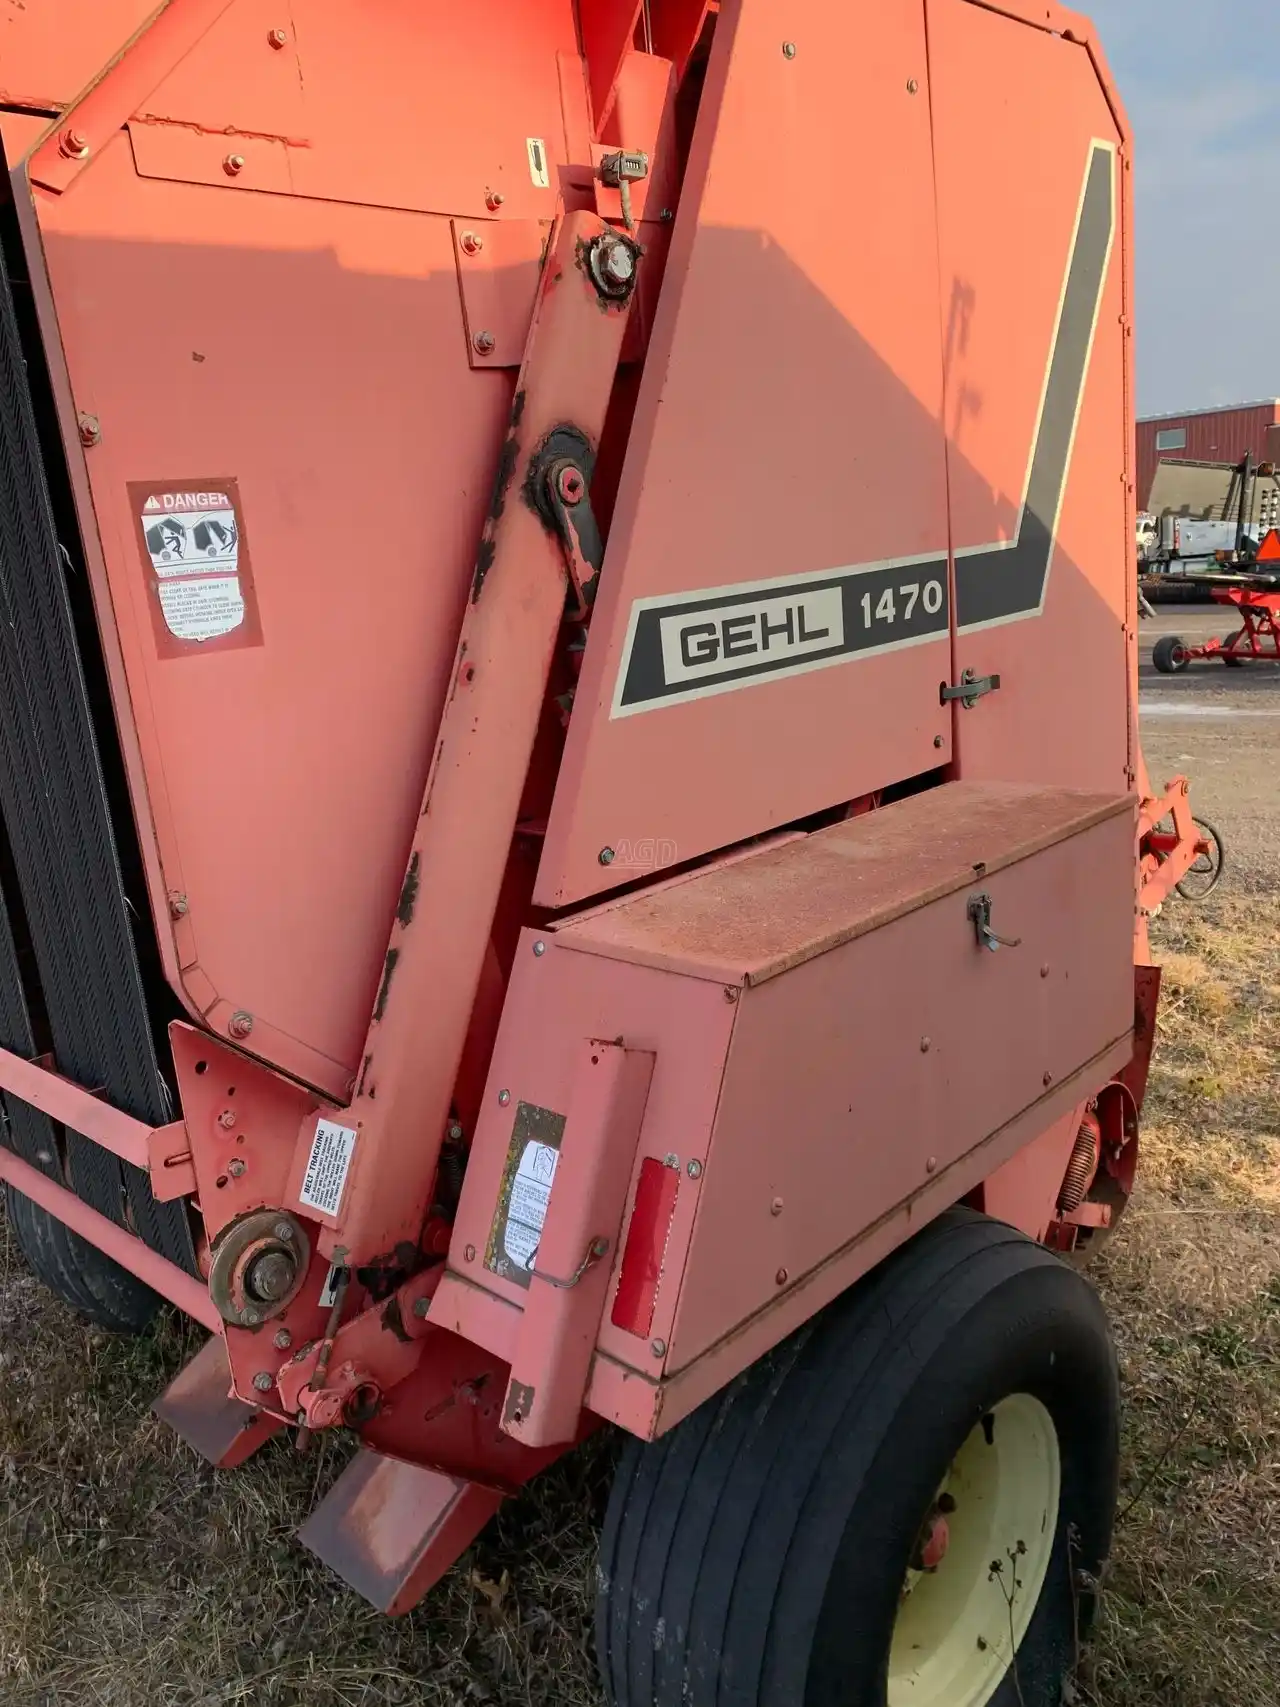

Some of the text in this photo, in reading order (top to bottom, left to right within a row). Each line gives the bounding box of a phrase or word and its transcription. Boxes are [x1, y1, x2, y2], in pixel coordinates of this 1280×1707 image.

[162, 492, 229, 509] DANGER
[680, 580, 943, 668] GEHL 1470
[304, 1129, 324, 1194] BELT TRACKING
